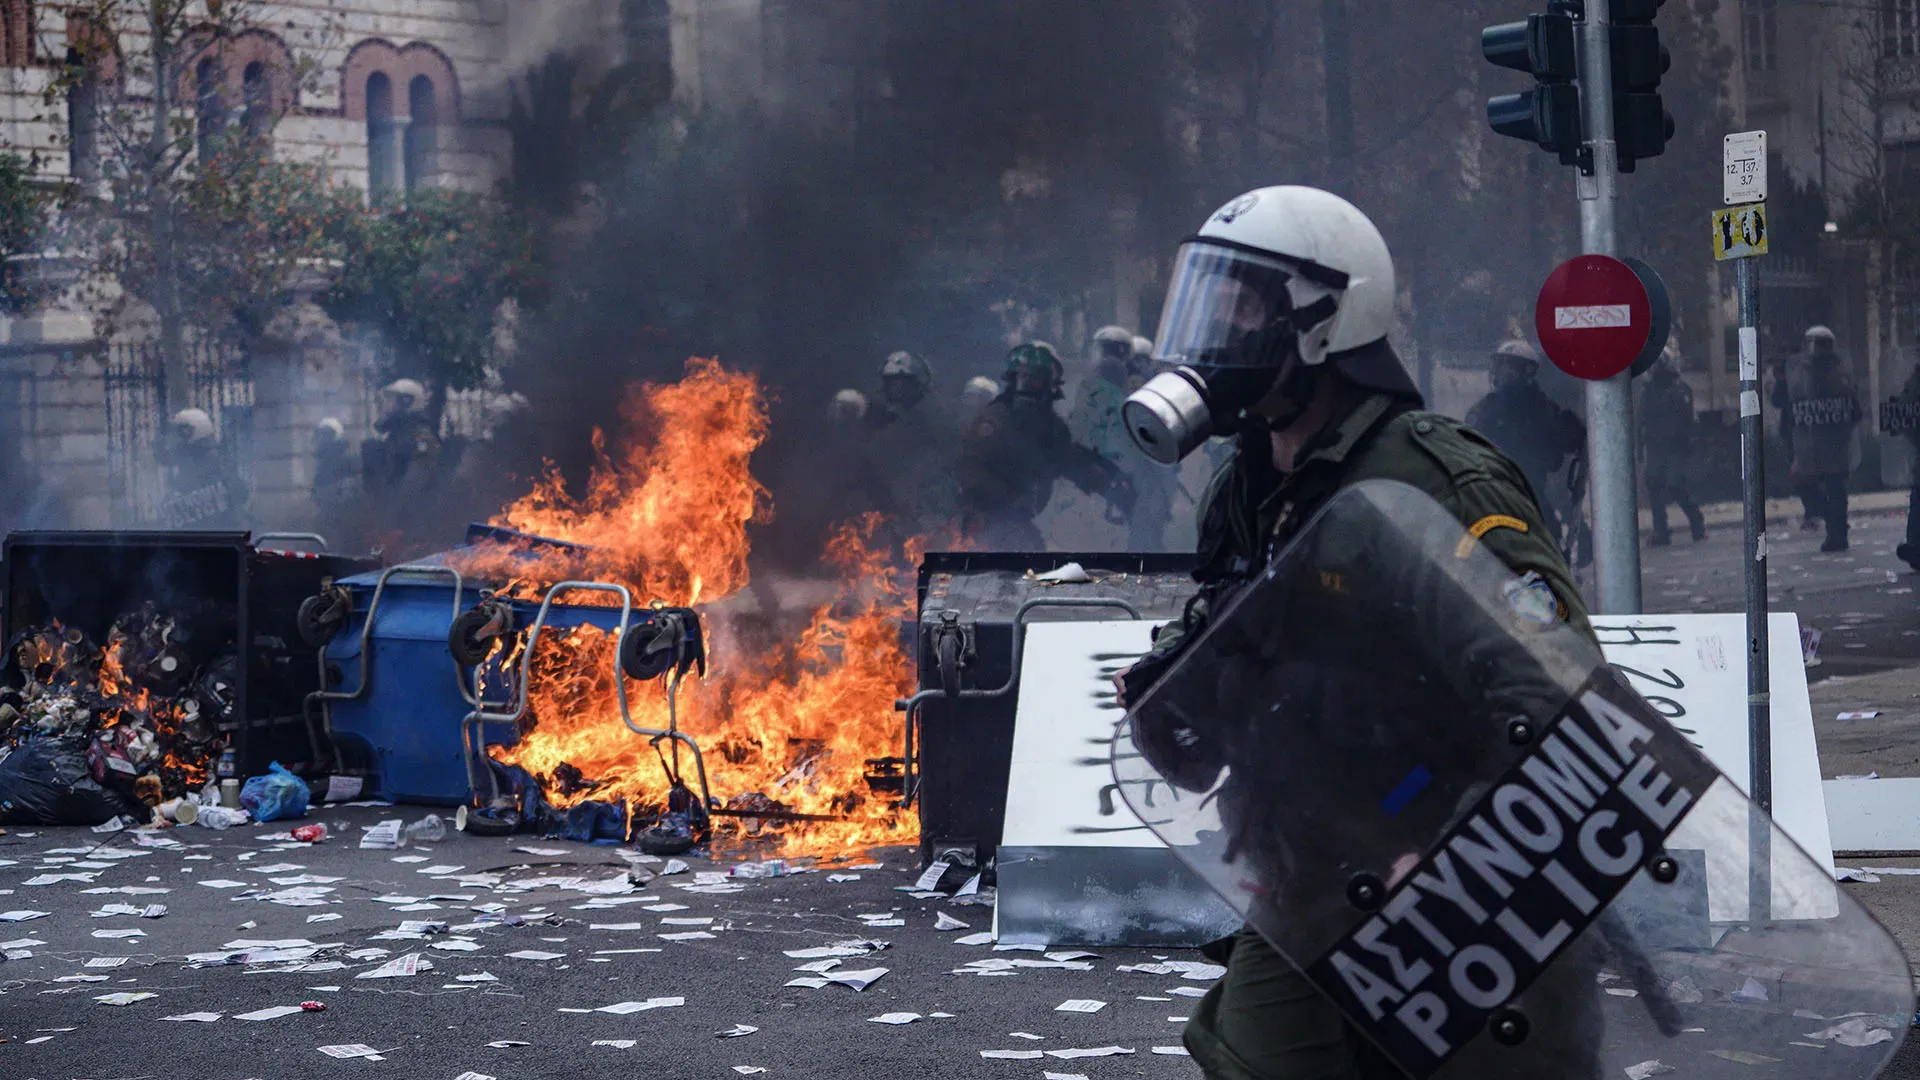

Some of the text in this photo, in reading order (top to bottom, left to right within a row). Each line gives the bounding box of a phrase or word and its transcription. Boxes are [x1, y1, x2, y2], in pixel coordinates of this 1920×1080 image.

[1719, 210, 1764, 250] 10
[1330, 690, 1654, 1022] ΑΣΤΥΝΟΜΙΑ
[1394, 754, 1692, 1059] POLICE
